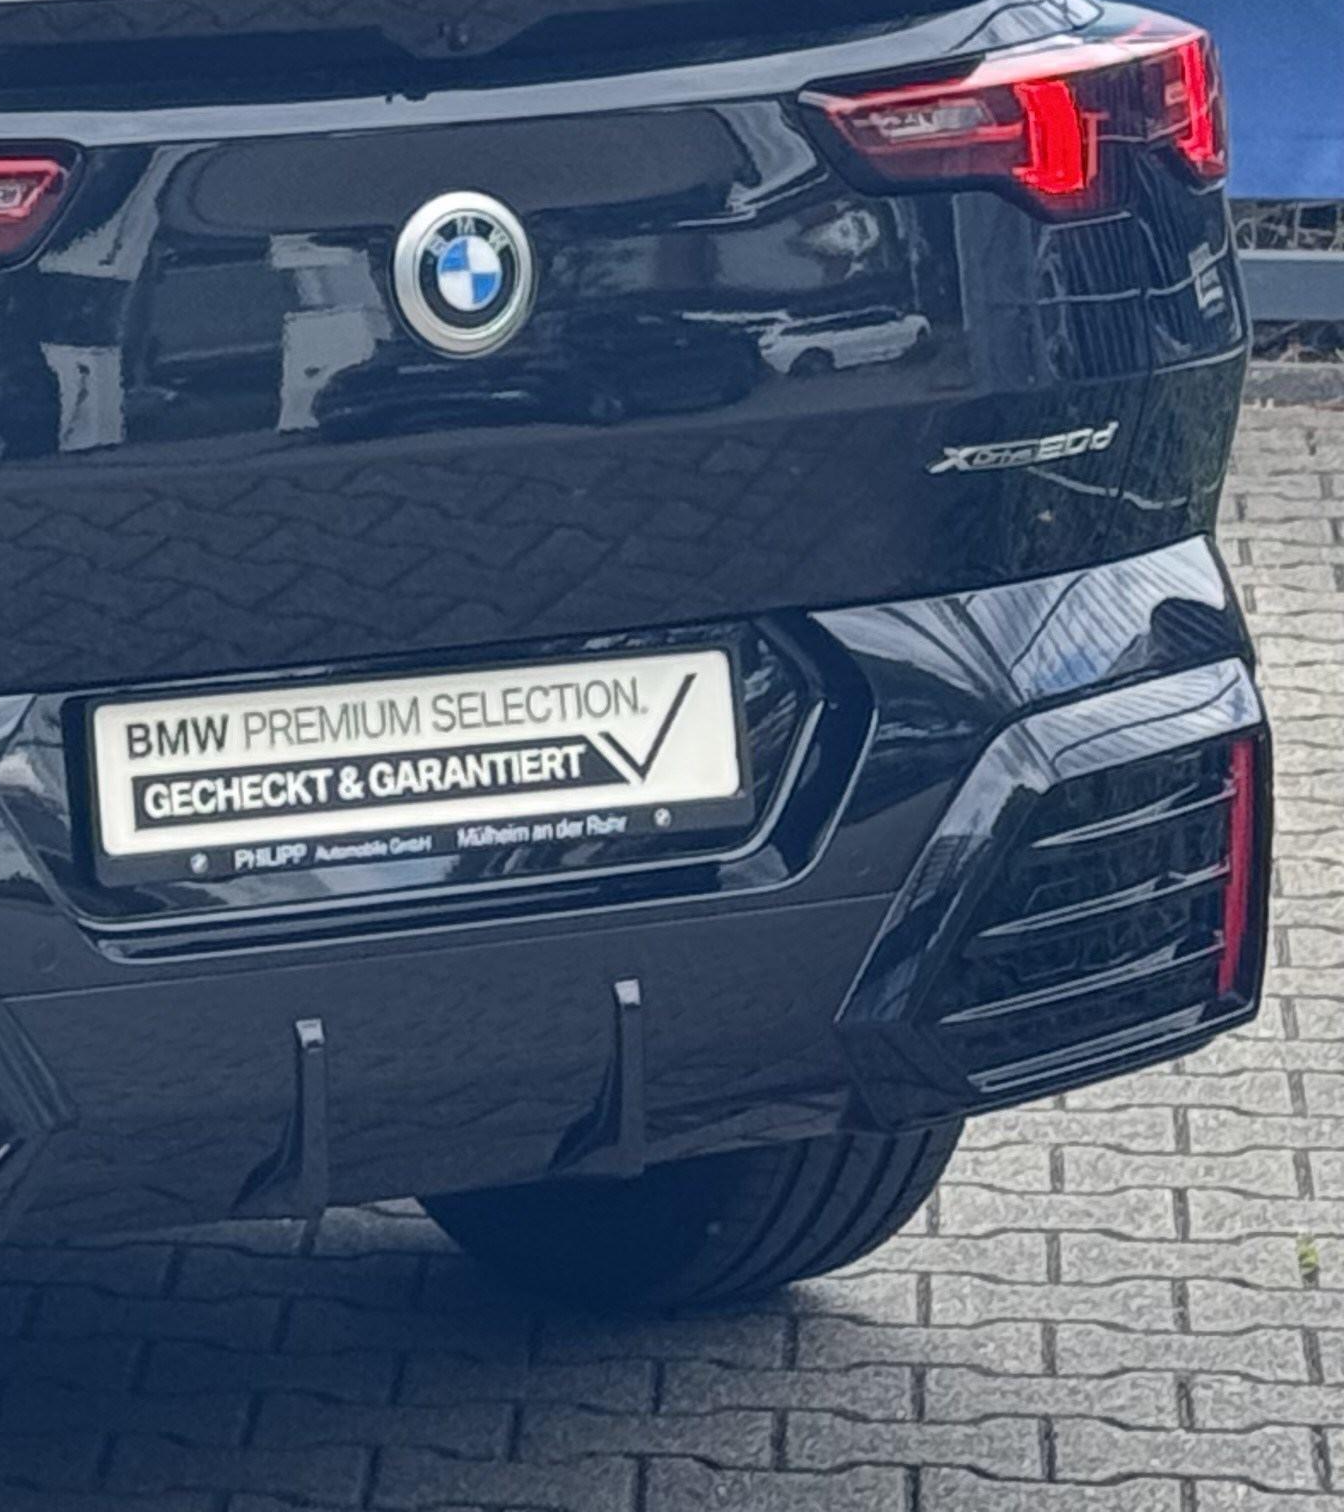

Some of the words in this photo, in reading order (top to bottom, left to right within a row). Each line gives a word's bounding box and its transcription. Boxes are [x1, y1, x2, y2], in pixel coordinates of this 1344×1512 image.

[126, 713, 229, 760] BMW
[242, 696, 422, 749] PREMIUM
[431, 676, 649, 733] SELECTION.
[143, 768, 334, 820] GECHECKT
[337, 765, 366, 800] &
[368, 742, 588, 798] GARANTIERT
[233, 842, 308, 871] PHILIPP
[532, 822, 553, 841] an
[556, 817, 584, 838] der
